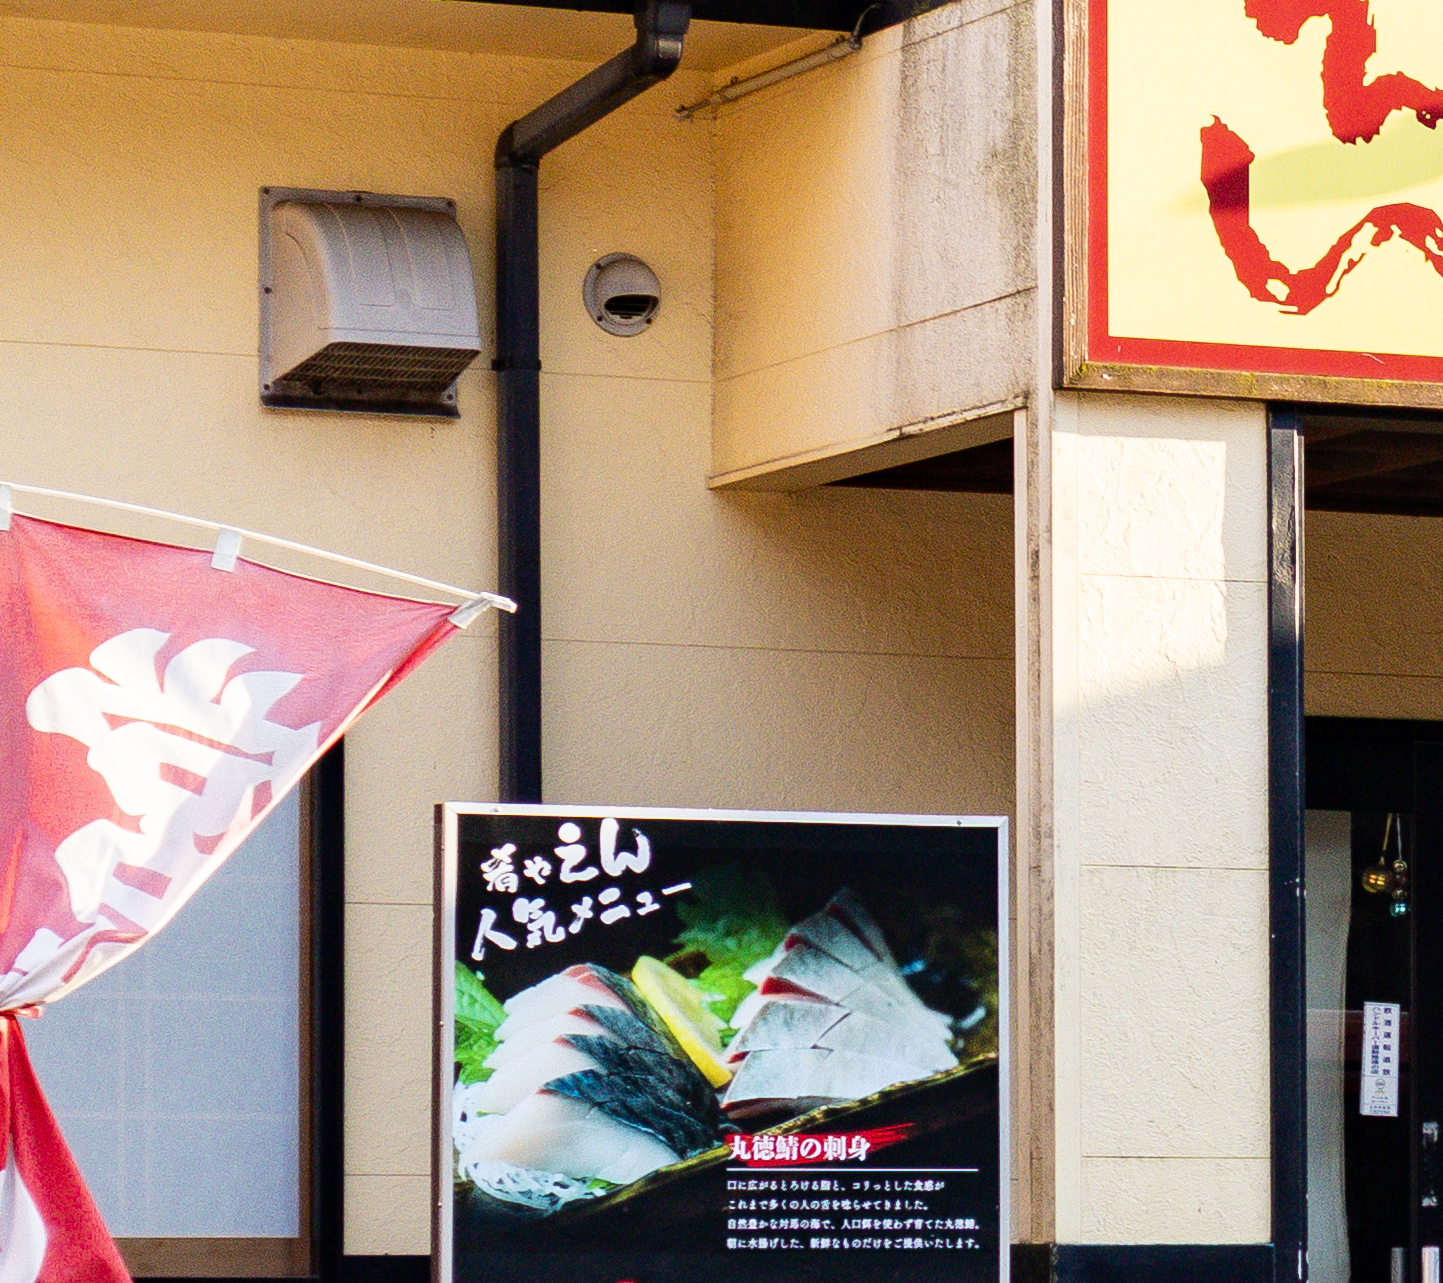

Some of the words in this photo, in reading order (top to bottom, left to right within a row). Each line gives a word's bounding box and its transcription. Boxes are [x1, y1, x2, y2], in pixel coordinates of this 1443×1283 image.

[480, 817, 652, 894] 肴やえん
[471, 882, 693, 962] 人気メニュー
[729, 1135, 871, 1161] 丸徳鯖の刺身
